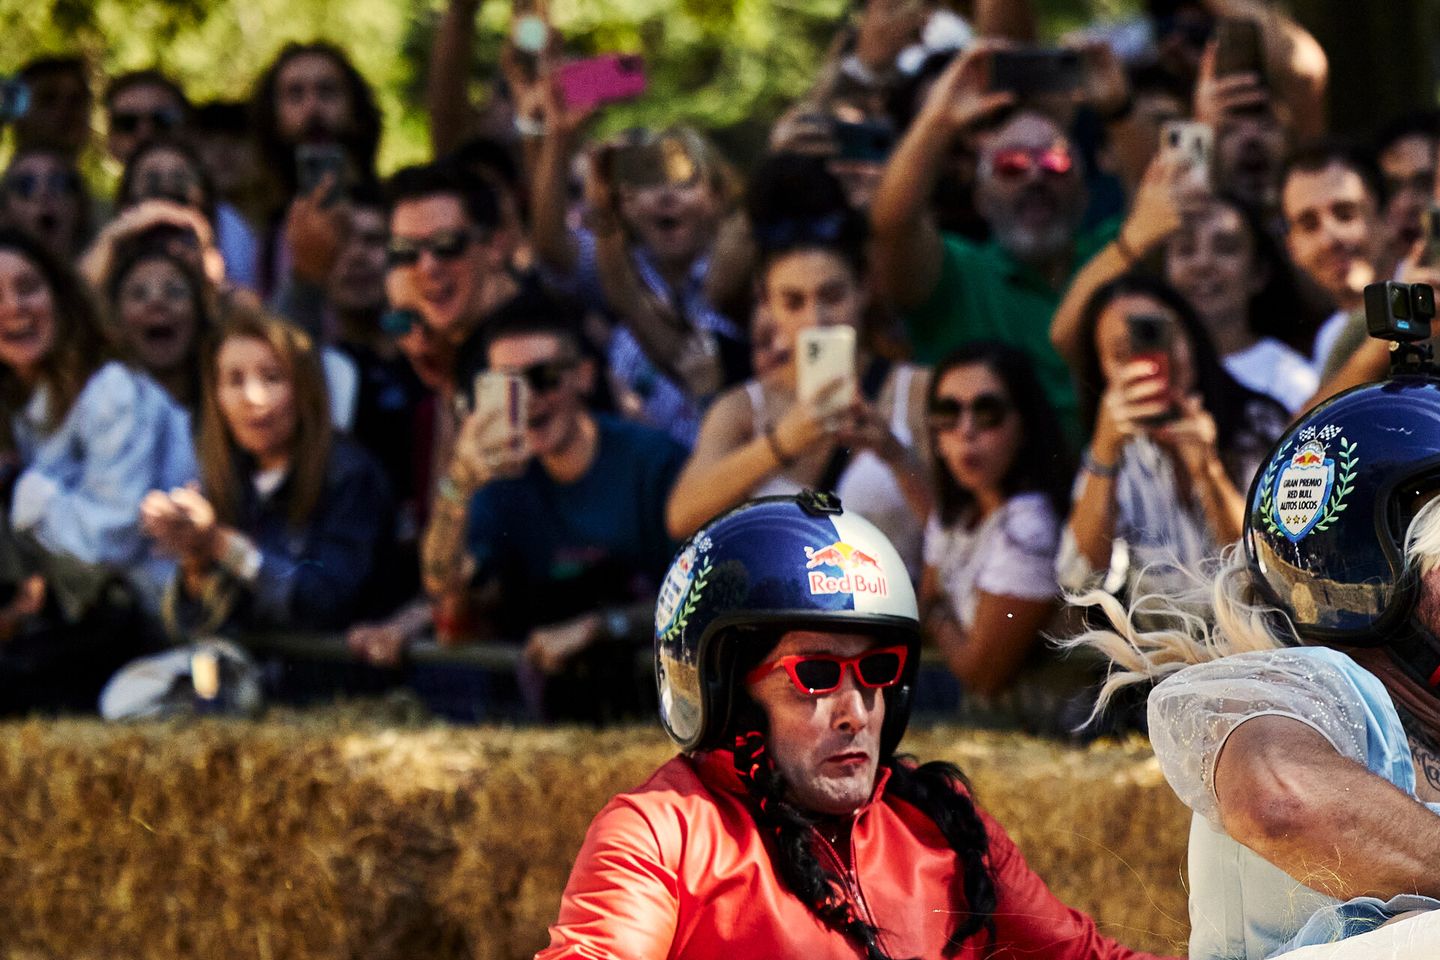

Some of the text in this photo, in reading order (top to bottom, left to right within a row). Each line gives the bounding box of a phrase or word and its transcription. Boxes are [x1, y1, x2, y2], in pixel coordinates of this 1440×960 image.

[1283, 478, 1323, 488] GRAN PREMIO
[1287, 490, 1312, 499] RED BULL
[1280, 500, 1318, 511] AUTOS LOCOS
[811, 573, 887, 596] Red Bull
